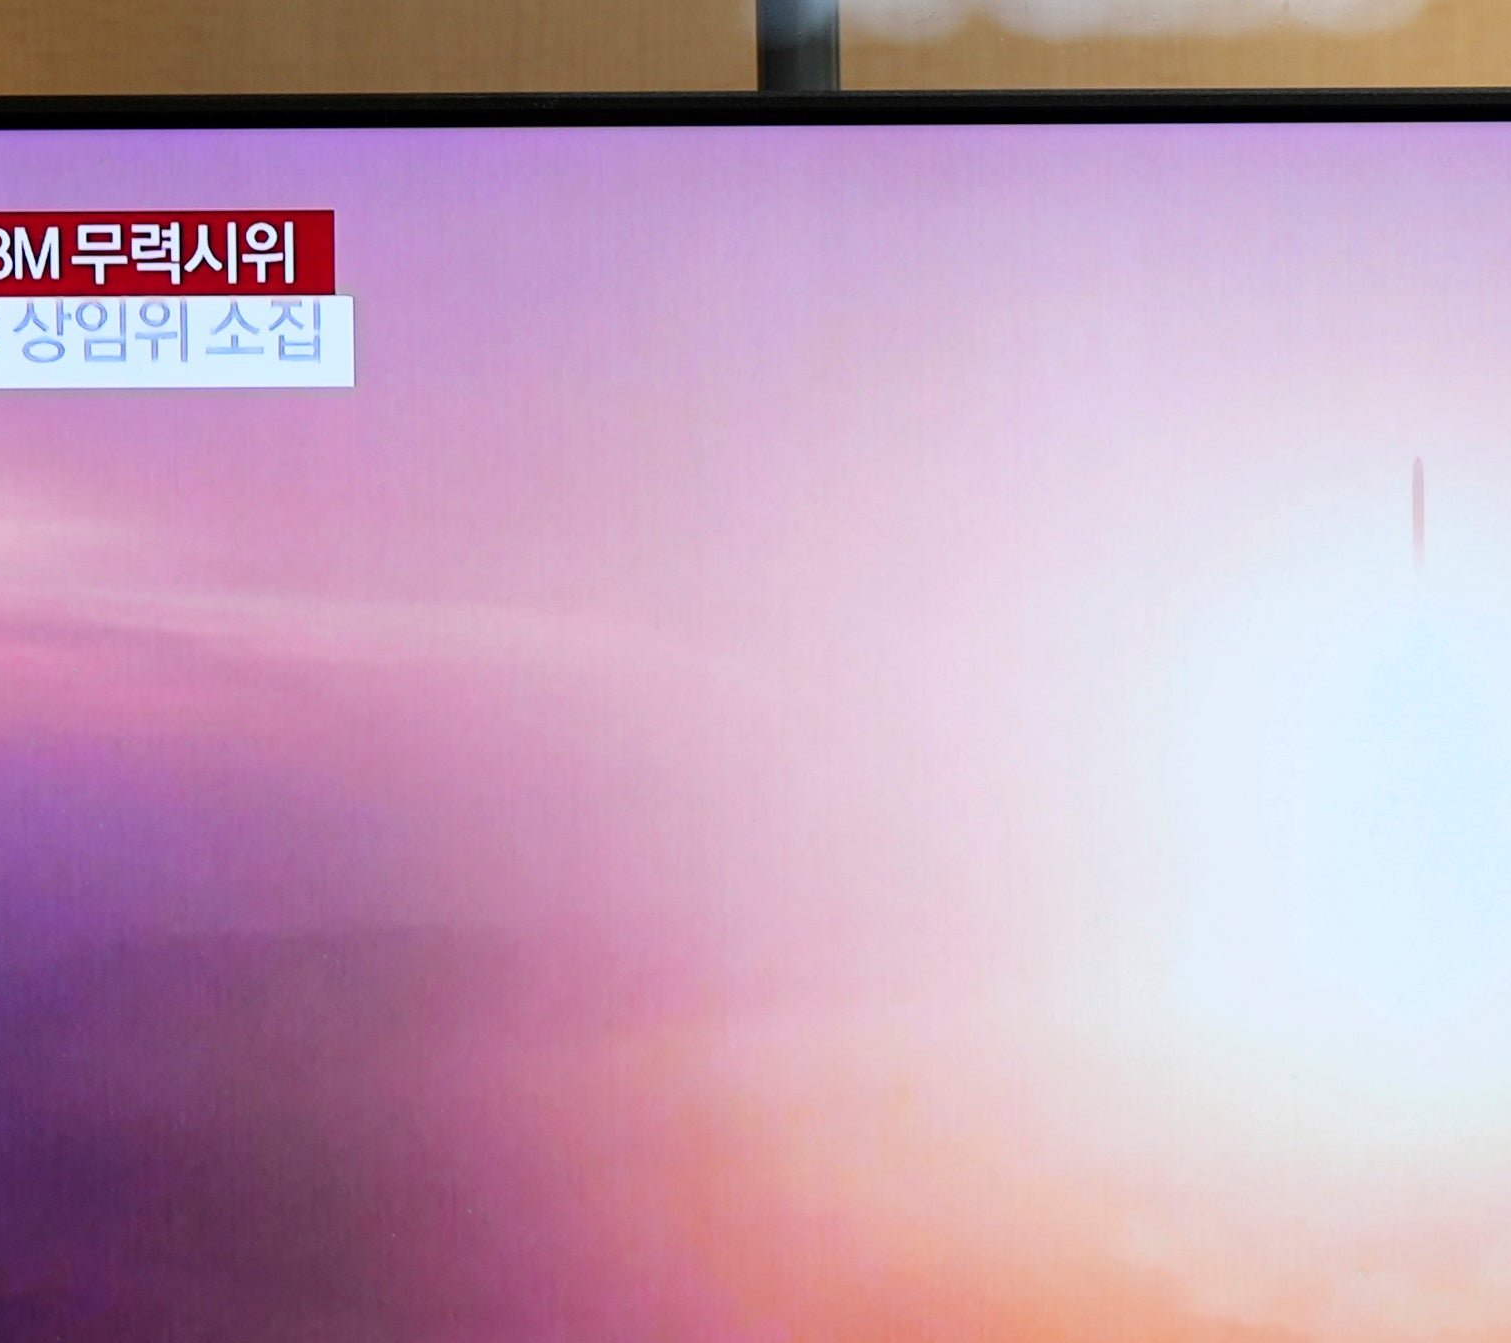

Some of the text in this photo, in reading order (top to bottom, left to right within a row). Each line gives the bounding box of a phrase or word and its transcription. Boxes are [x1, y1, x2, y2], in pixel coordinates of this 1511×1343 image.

[71, 221, 297, 286] 무력시위
[12, 299, 191, 364] 상임위
[204, 299, 323, 364] 소집
